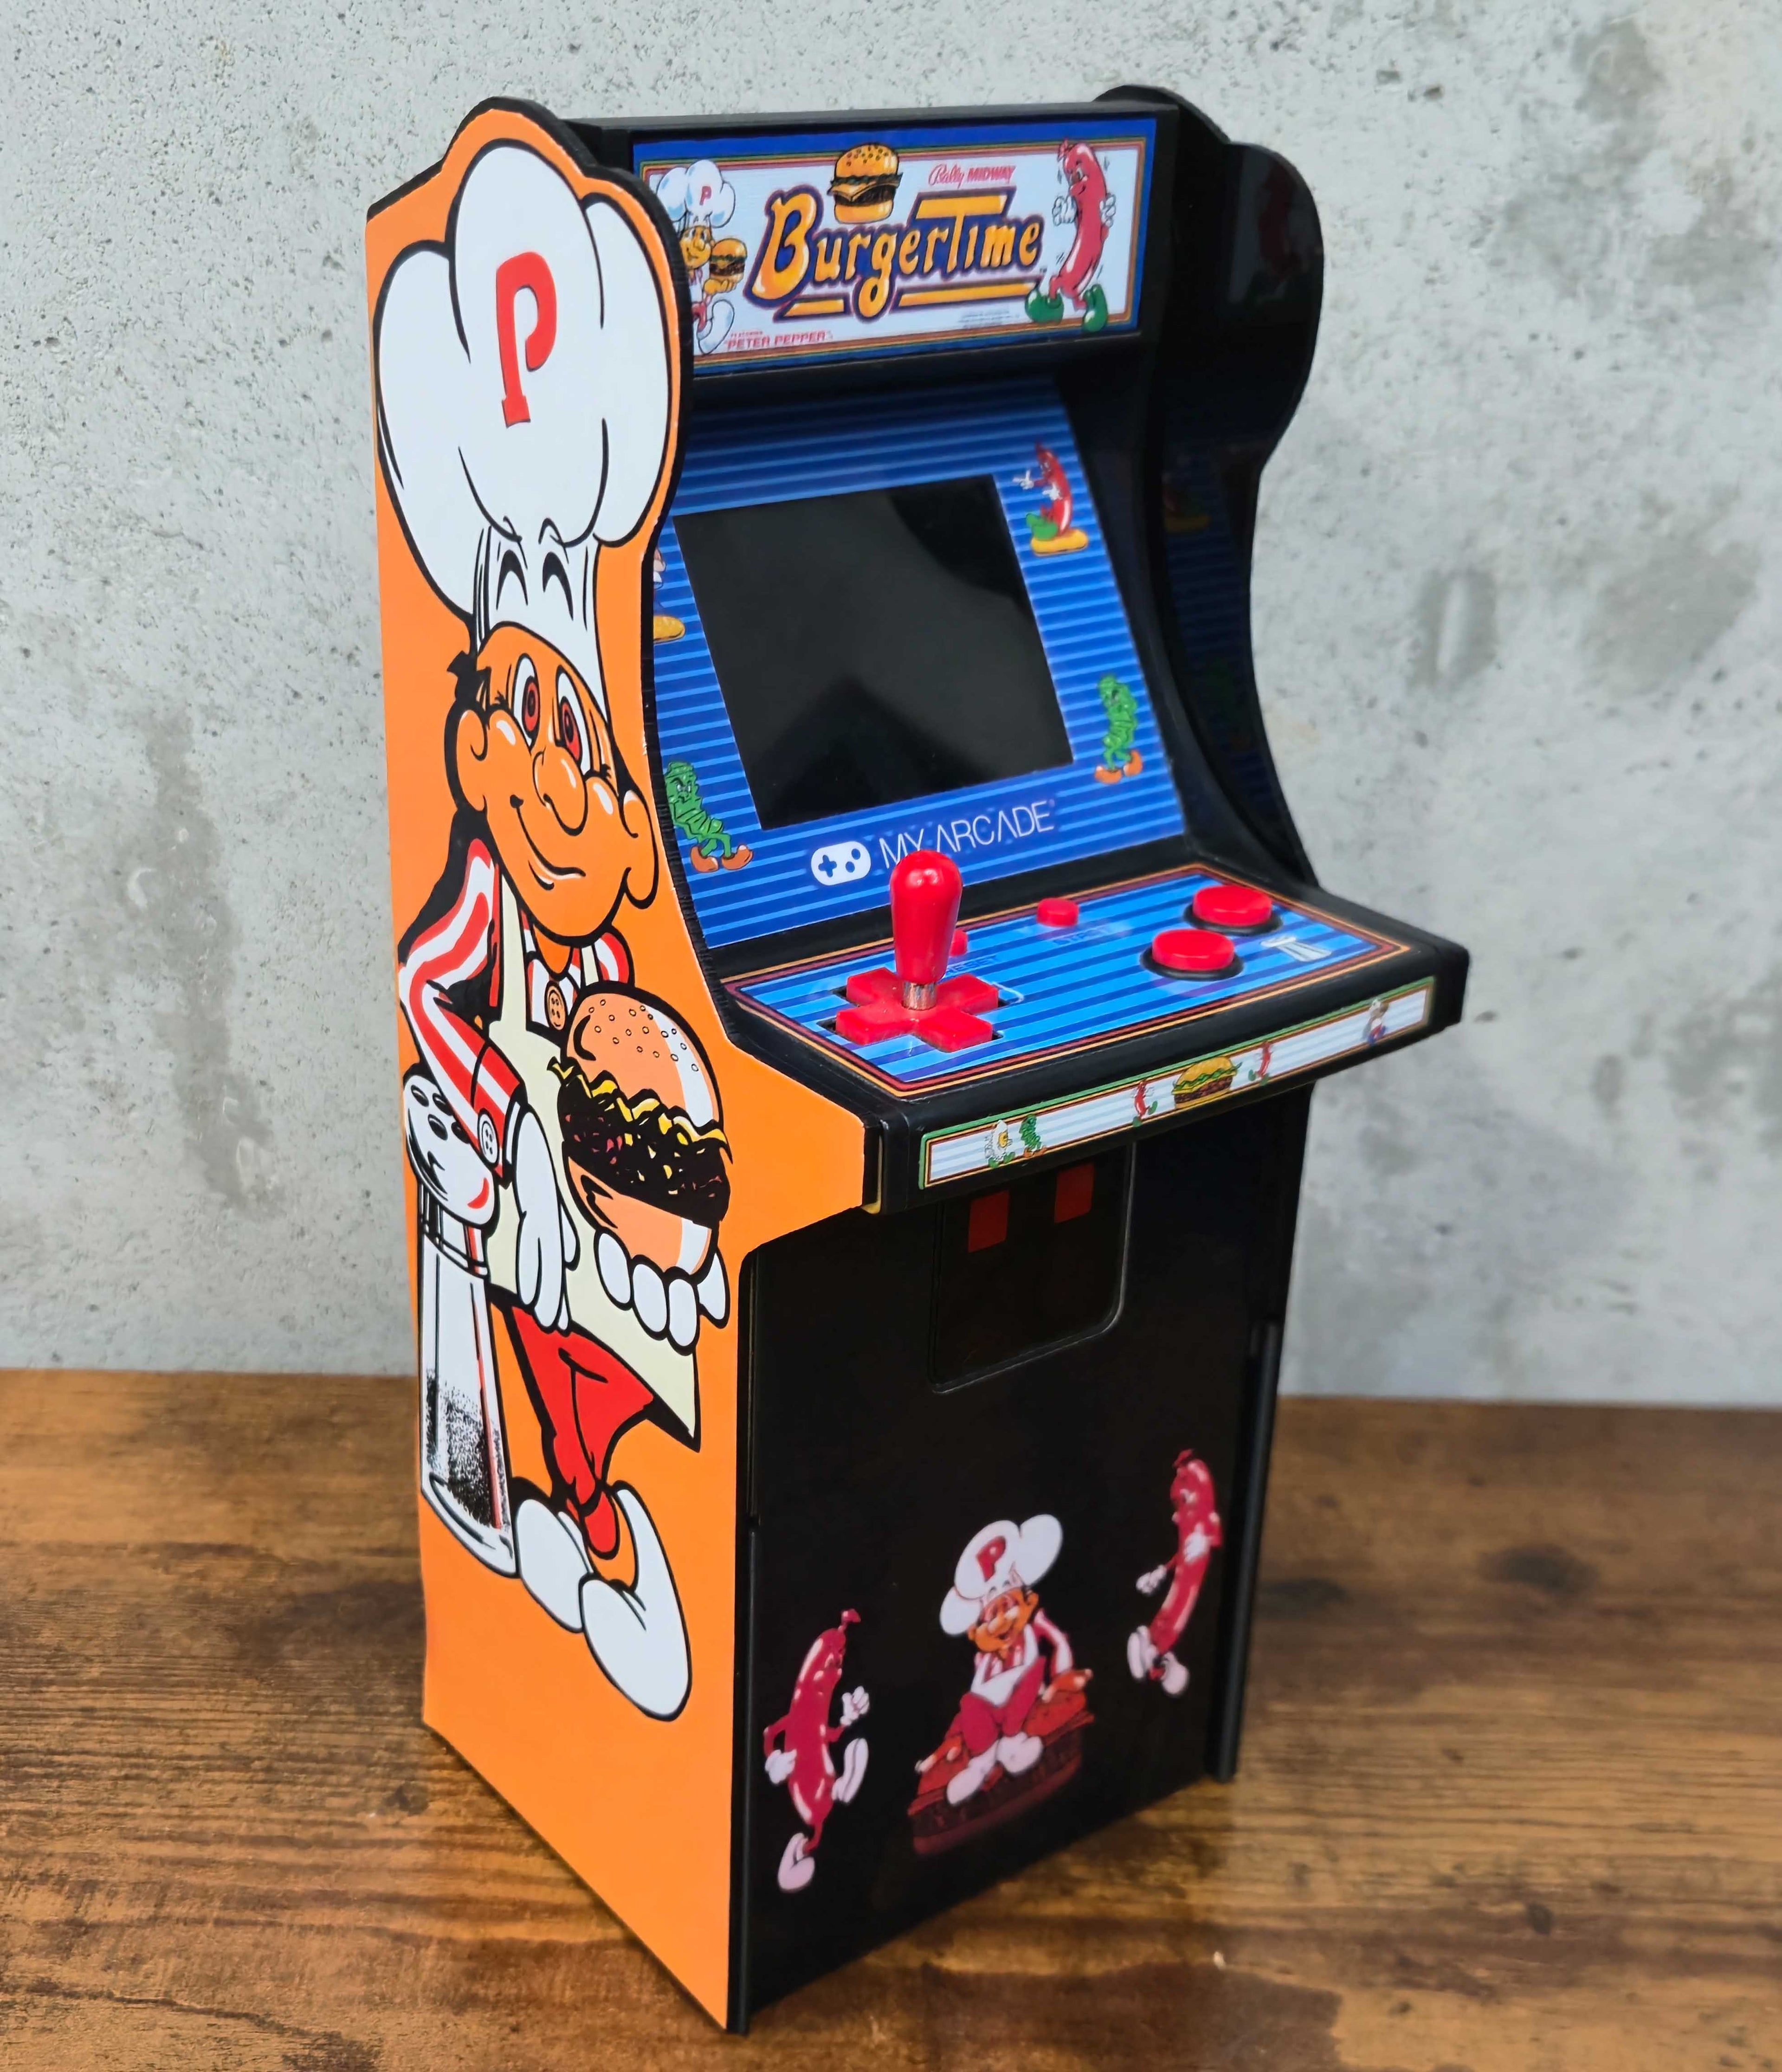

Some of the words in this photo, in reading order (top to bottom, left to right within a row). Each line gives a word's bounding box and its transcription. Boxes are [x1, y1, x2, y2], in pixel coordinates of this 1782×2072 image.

[699, 186, 712, 206] P
[967, 165, 1016, 184] MIDWAY
[496, 252, 557, 428] P
[936, 800, 1054, 853] ARCADE
[976, 1535, 1006, 1582] P
